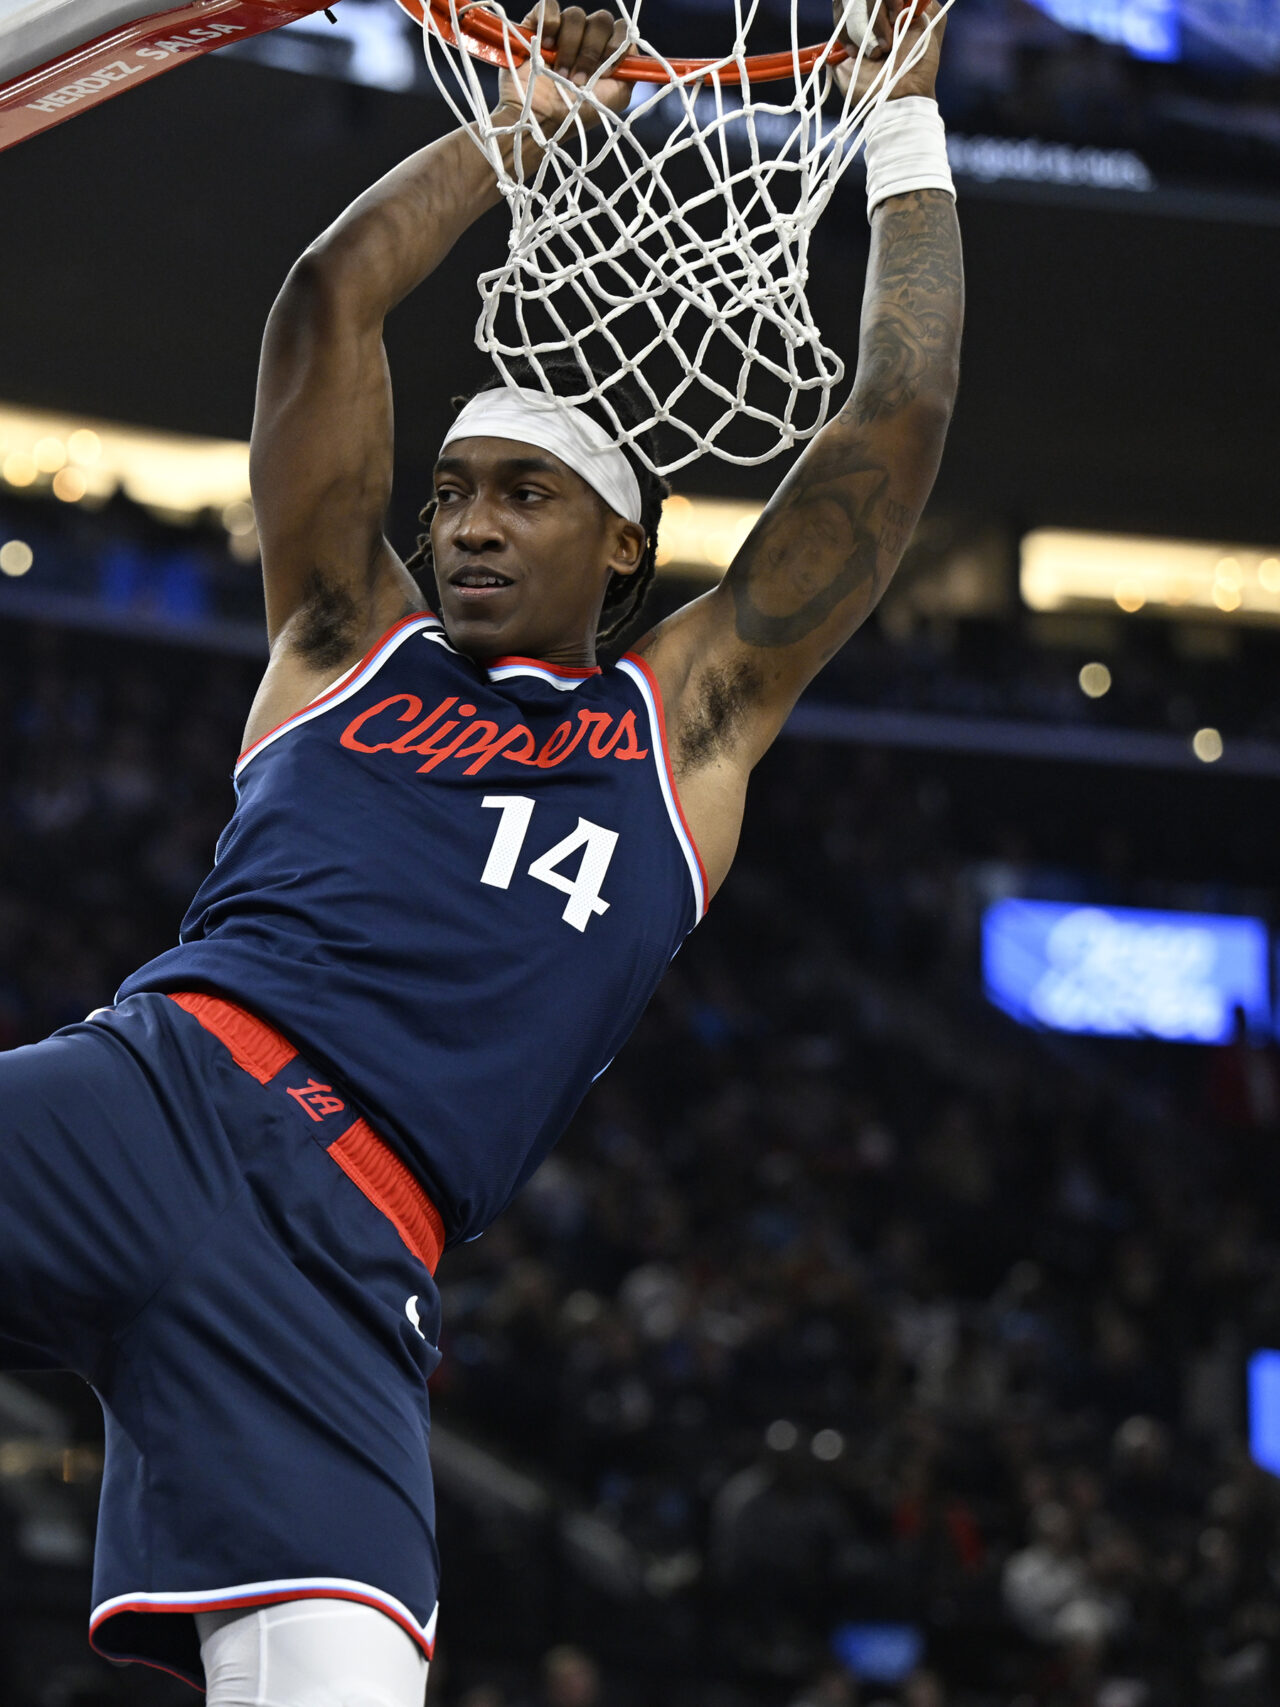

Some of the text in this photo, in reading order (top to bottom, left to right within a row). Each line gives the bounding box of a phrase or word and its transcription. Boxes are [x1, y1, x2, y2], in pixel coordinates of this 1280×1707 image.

[25, 23, 247, 113] HERDEZ SALSA
[339, 693, 649, 776] Clippers
[479, 795, 620, 933] 14
[286, 1077, 345, 1122] LA
